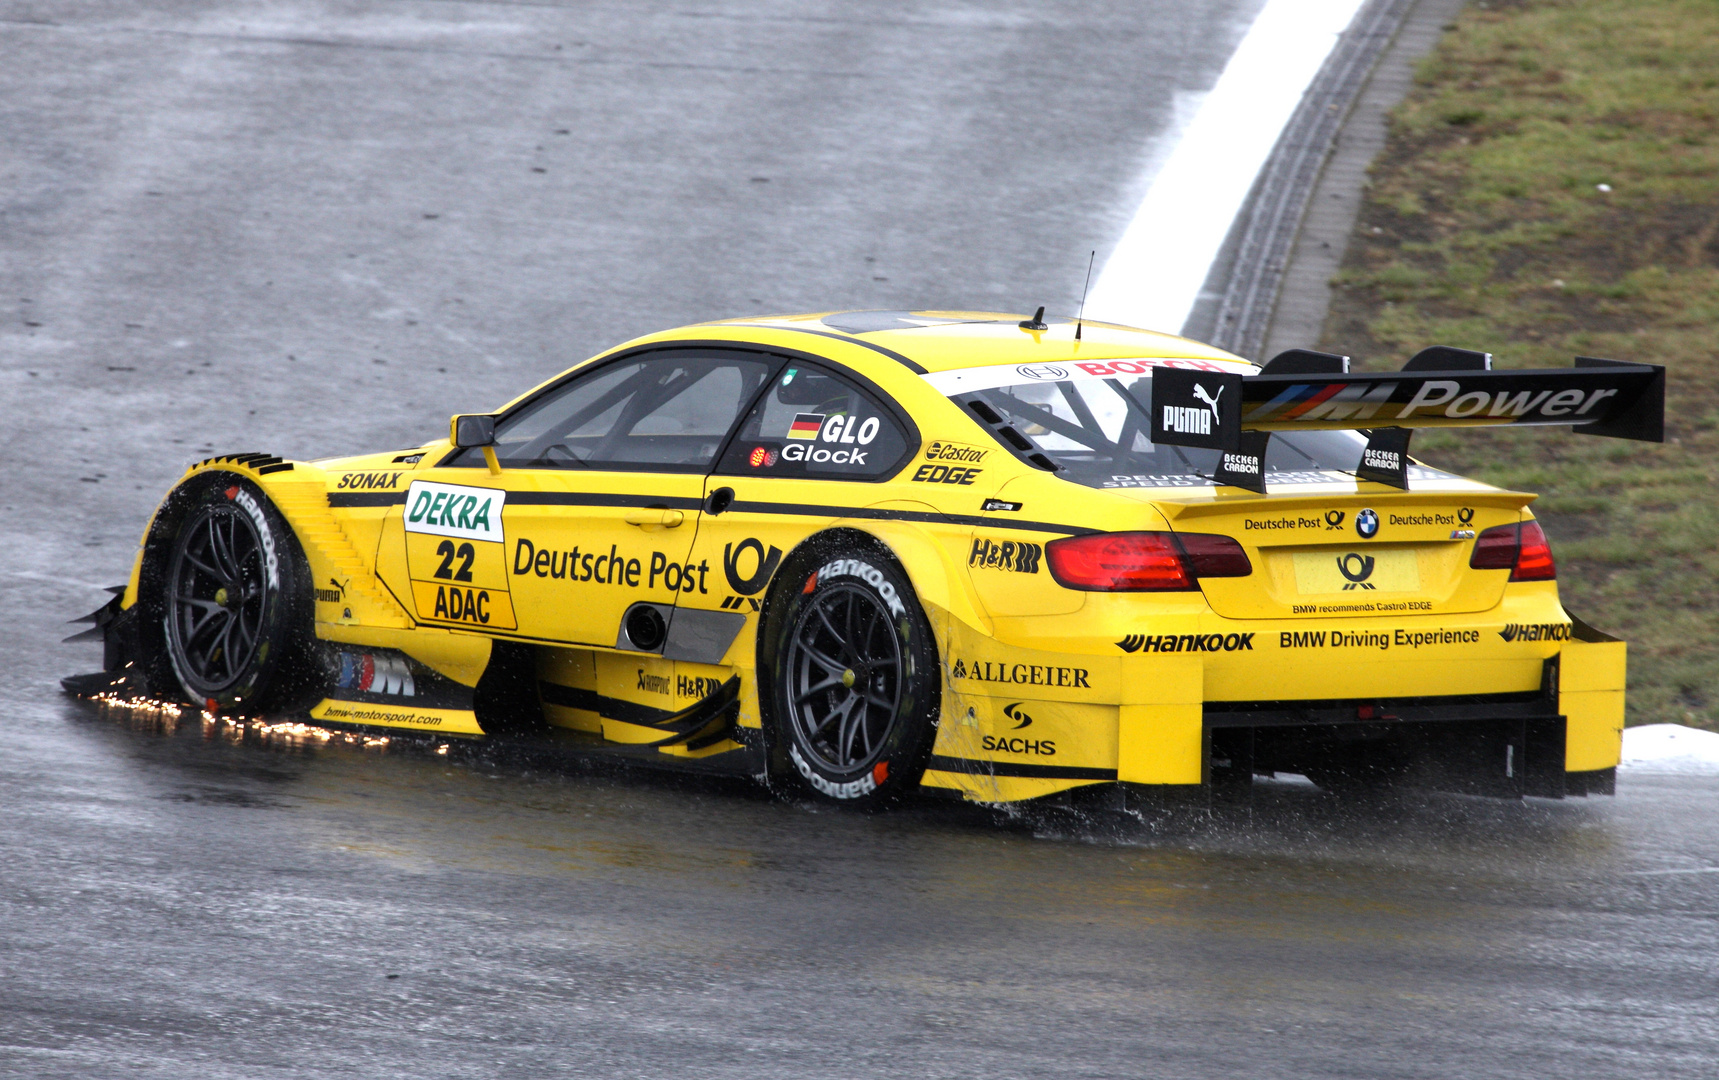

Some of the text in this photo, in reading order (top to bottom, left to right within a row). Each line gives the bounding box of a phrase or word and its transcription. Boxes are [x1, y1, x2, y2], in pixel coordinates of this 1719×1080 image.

[1395, 380, 1618, 419] Power
[822, 414, 880, 445] GLO
[1163, 405, 1211, 435] PUMA
[781, 443, 869, 465] Glock
[938, 444, 988, 463] Castrol
[1224, 453, 1258, 465] BECKER
[1365, 449, 1399, 461] BECKER
[1365, 458, 1399, 471] CARBON
[911, 464, 984, 486] EDGE
[1224, 462, 1258, 475] CARBON
[337, 472, 404, 489] SONAX
[409, 490, 492, 531] DEKRA
[1389, 513, 1454, 526] Deutsche Post
[1245, 516, 1321, 530] Deutsche Post
[433, 540, 475, 582] 22
[969, 538, 1017, 572] H&R
[513, 538, 709, 595] Deutsche Post
[434, 586, 490, 623] ADAC
[1293, 601, 1433, 614] BMW recommends Castrol EDGE
[1280, 628, 1479, 650] BMW Driving Experience
[969, 660, 1091, 688] ALLGEIER
[677, 675, 704, 698] H&R
[323, 706, 442, 726] bmw-motorsport.com
[982, 735, 1056, 755] SACHS
